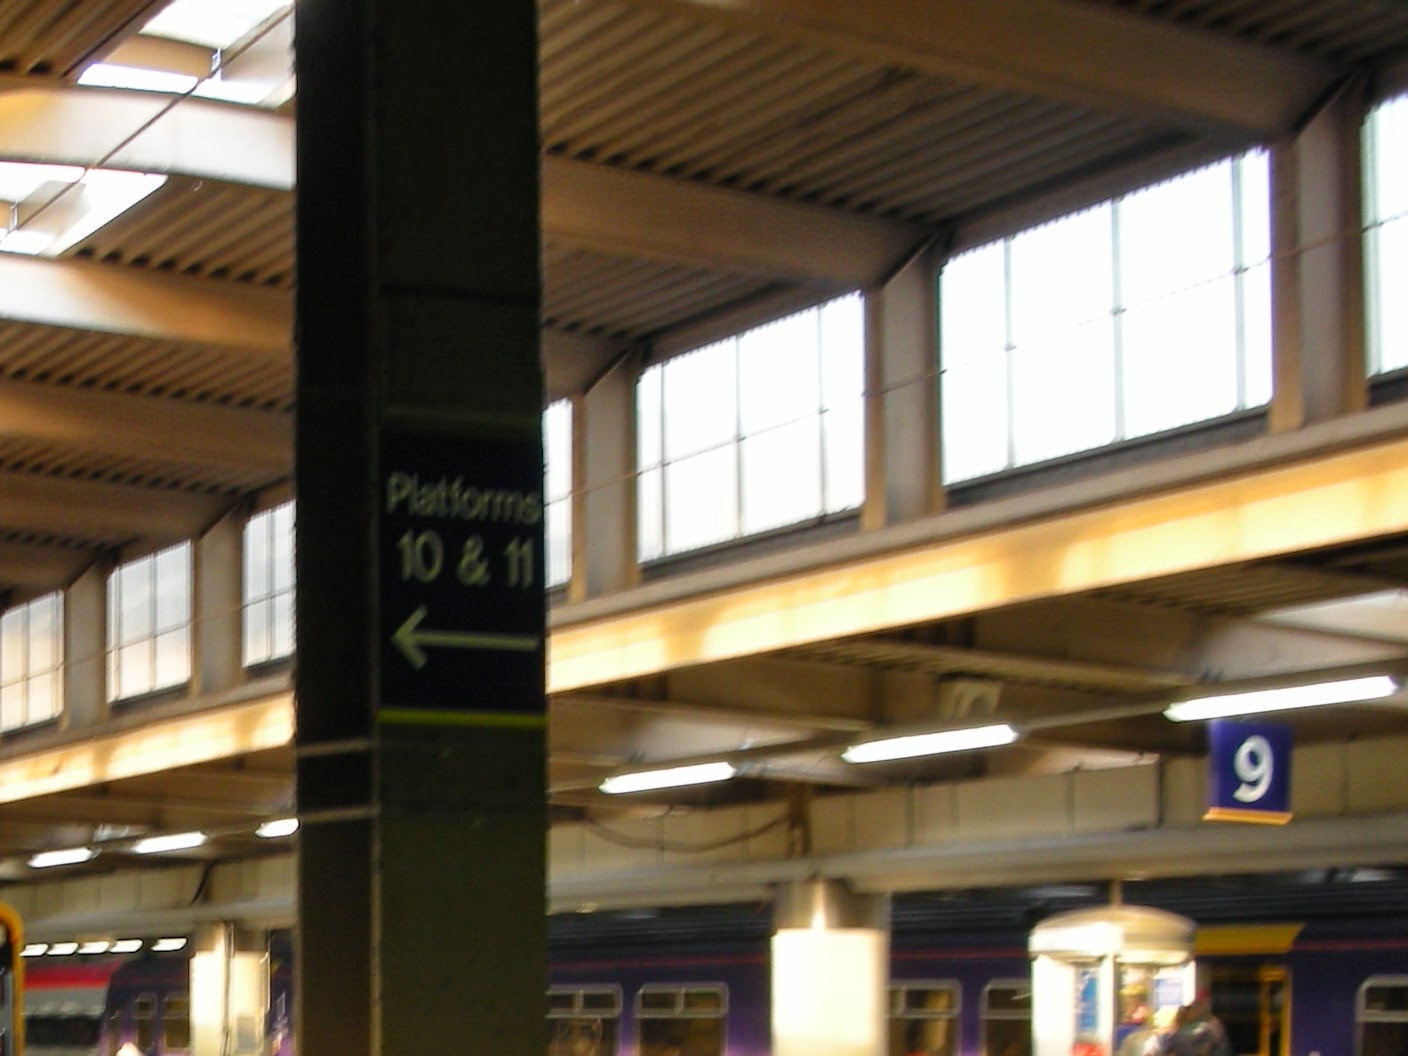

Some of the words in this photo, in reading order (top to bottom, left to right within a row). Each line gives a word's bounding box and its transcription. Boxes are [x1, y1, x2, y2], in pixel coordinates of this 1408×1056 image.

[386, 471, 541, 525] Platforms
[397, 529, 444, 583] 10
[457, 534, 490, 585] &
[504, 536, 534, 588] 11
[1233, 735, 1274, 803] 9
